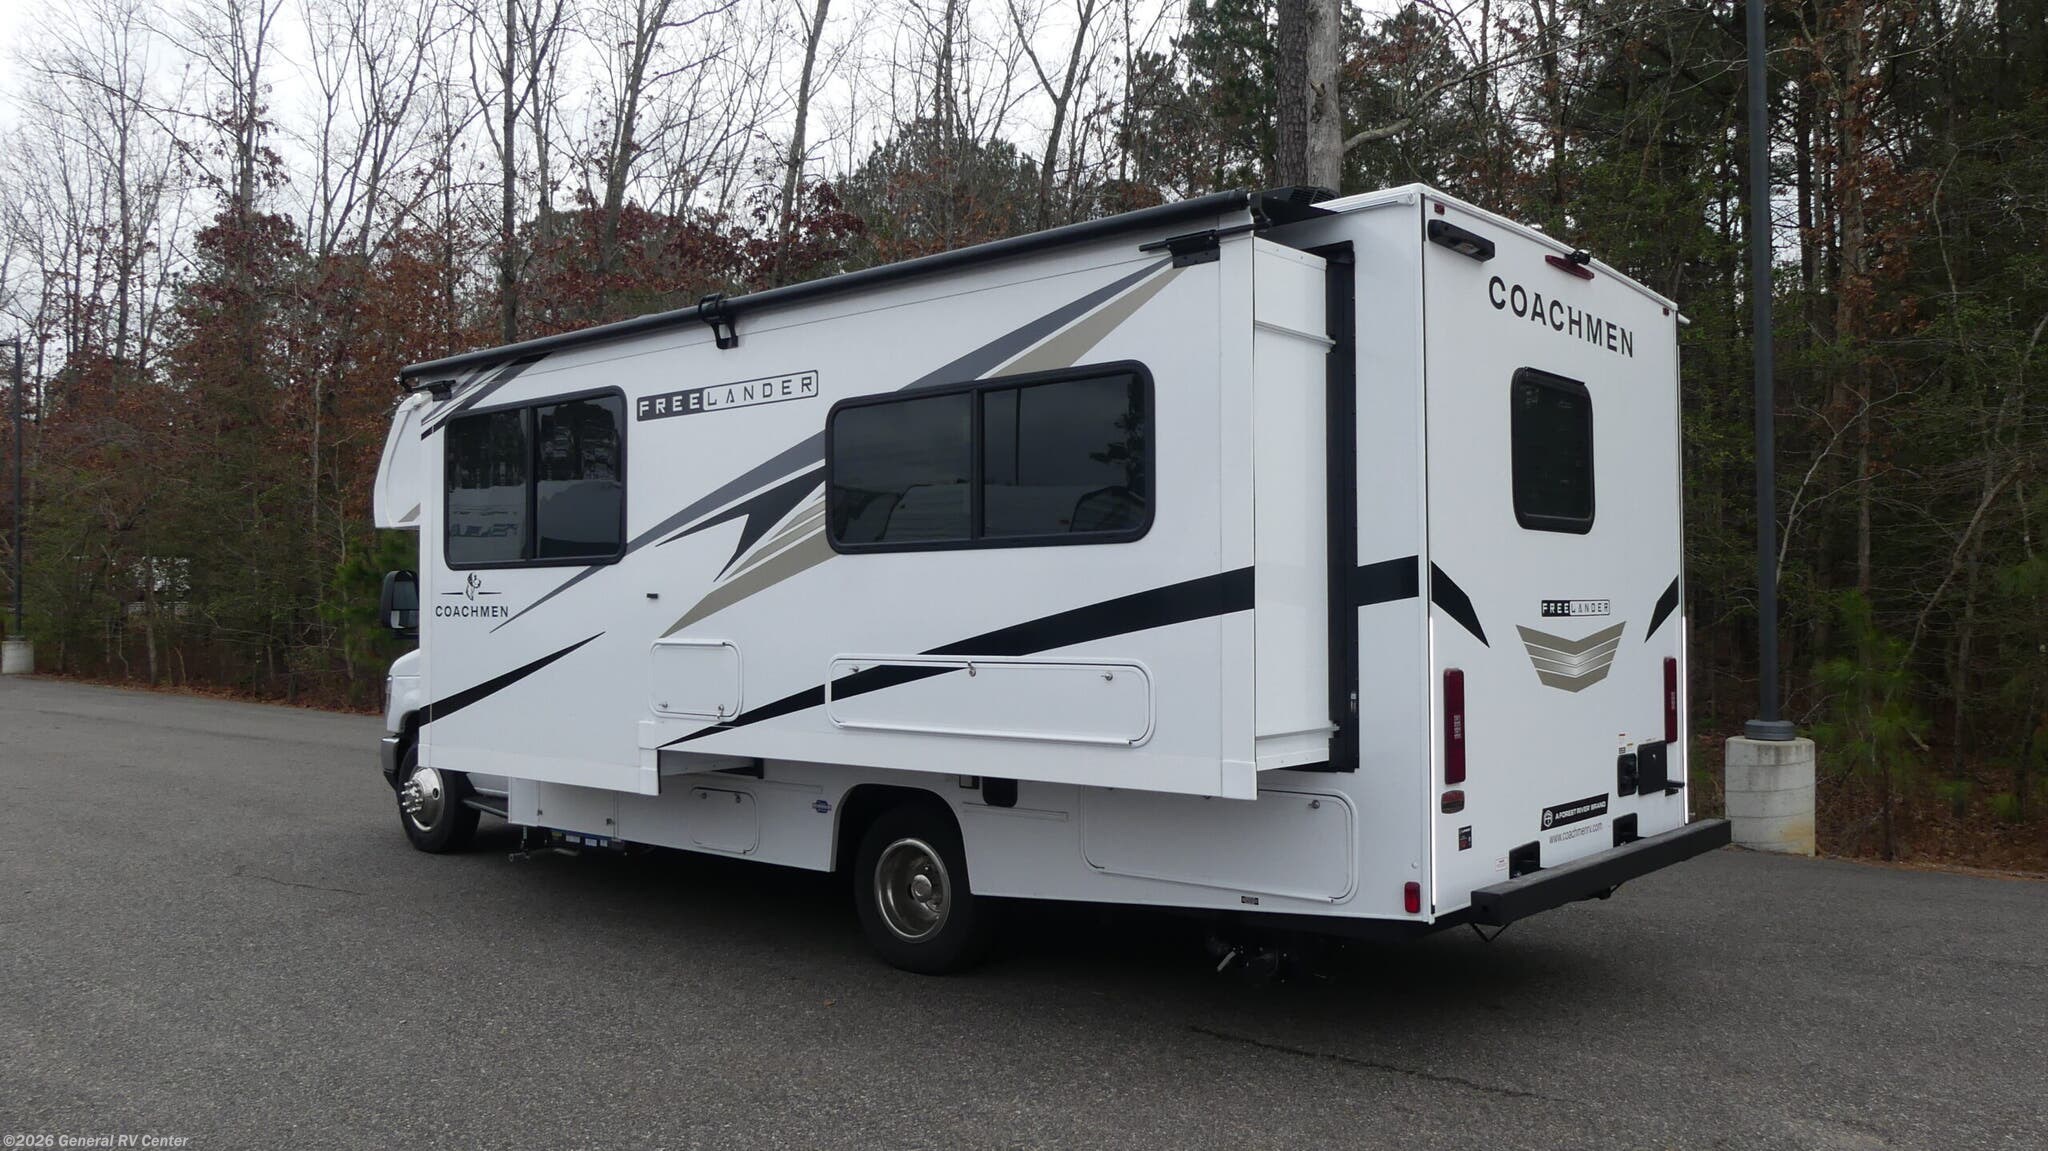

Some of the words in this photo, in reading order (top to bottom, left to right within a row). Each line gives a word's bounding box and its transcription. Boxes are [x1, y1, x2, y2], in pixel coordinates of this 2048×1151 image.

[1488, 275, 1633, 358] COACHMEN
[639, 376, 813, 417] FREELANDER
[435, 605, 509, 618] COACHMEN
[1542, 602, 1609, 614] FREELANDER
